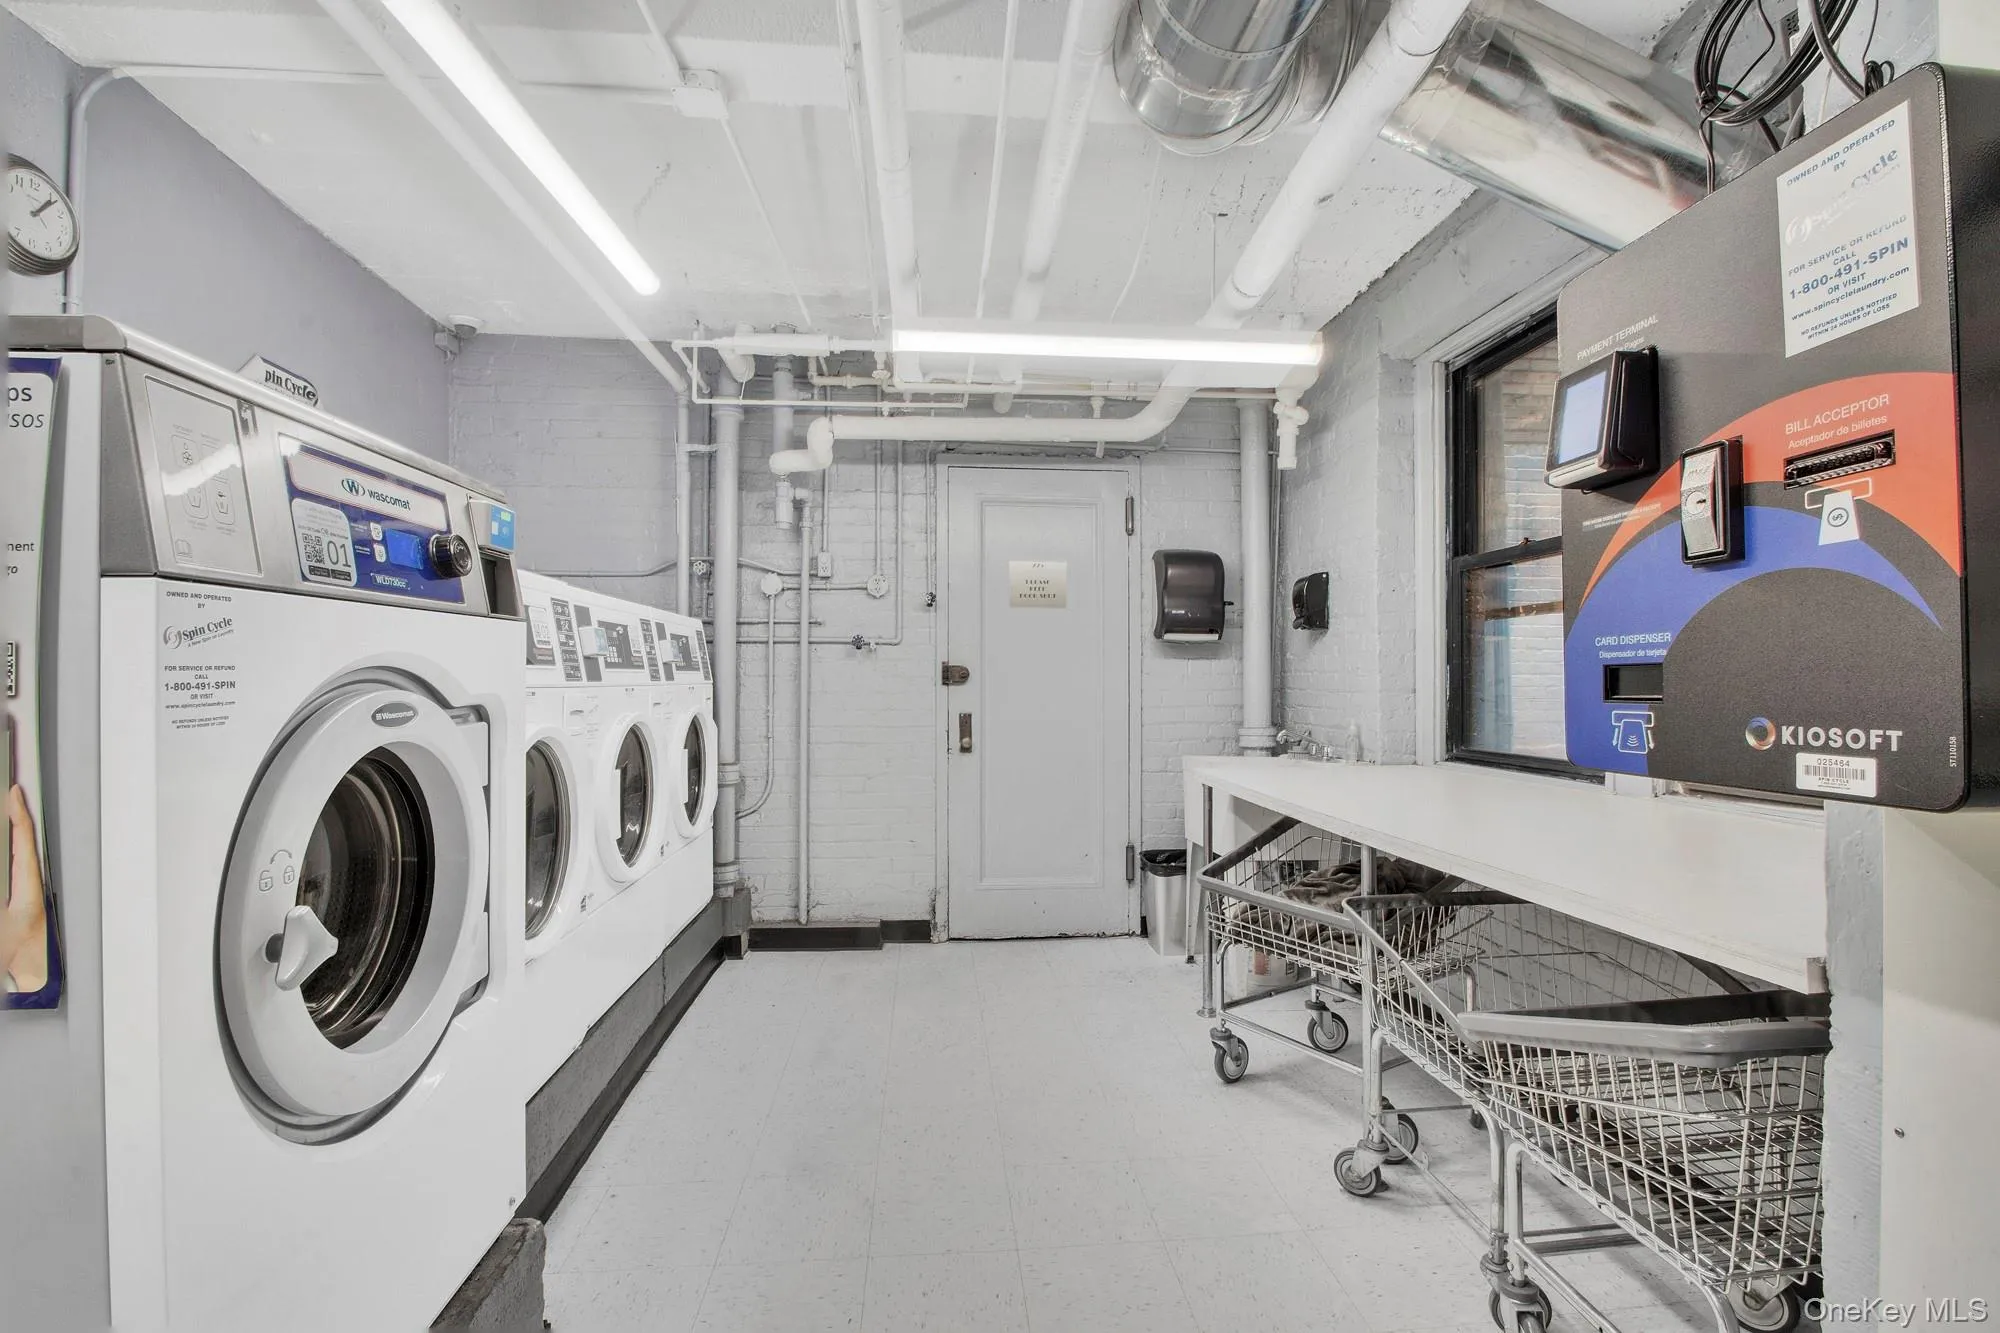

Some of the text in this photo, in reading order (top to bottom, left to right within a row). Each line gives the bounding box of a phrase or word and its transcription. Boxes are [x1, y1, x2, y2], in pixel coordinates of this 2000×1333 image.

[1786, 119, 1895, 187] OWNED AND OPERATED
[1833, 160, 1846, 172] BY
[1850, 149, 1898, 189] Cycle
[30, 178, 40, 191] 12
[1788, 215, 1907, 277] FOR SERVICE OR REFUND
[1833, 251, 1857, 266] CALL
[1790, 237, 1909, 299] 1-800-491-SPIN
[1791, 266, 1910, 321] www.spincyclelaundry.com
[1827, 272, 1867, 296] OR VISIT
[1807, 328, 1829, 340] WITHIN
[1839, 314, 1861, 327] HOURS
[1862, 310, 1871, 319] OF
[1872, 303, 1890, 314] LOSS
[1810, 317, 1839, 332] REFUNDS
[1840, 306, 1864, 320] UNLESS
[1866, 292, 1898, 309] NOTIFIED
[1577, 335, 1614, 360] PAYMENT
[1615, 315, 1659, 341] TERMINAL
[285, 377, 316, 401] Cycle
[1785, 393, 1890, 435] BILL ACCEPTOR
[1788, 415, 1888, 448] Aceptador de billetes
[367, 489, 411, 511] wascomat
[327, 541, 351, 567] 01
[203, 594, 232, 602] OPERATED
[182, 617, 233, 641] Spin Cycle
[1594, 632, 1672, 647] CARD DISPENSER
[1599, 649, 1636, 659] Dispensador
[1636, 649, 1645, 657] de
[164, 680, 236, 691] 1-800-491-SPIN
[1781, 725, 1903, 752] KIOSOFT
